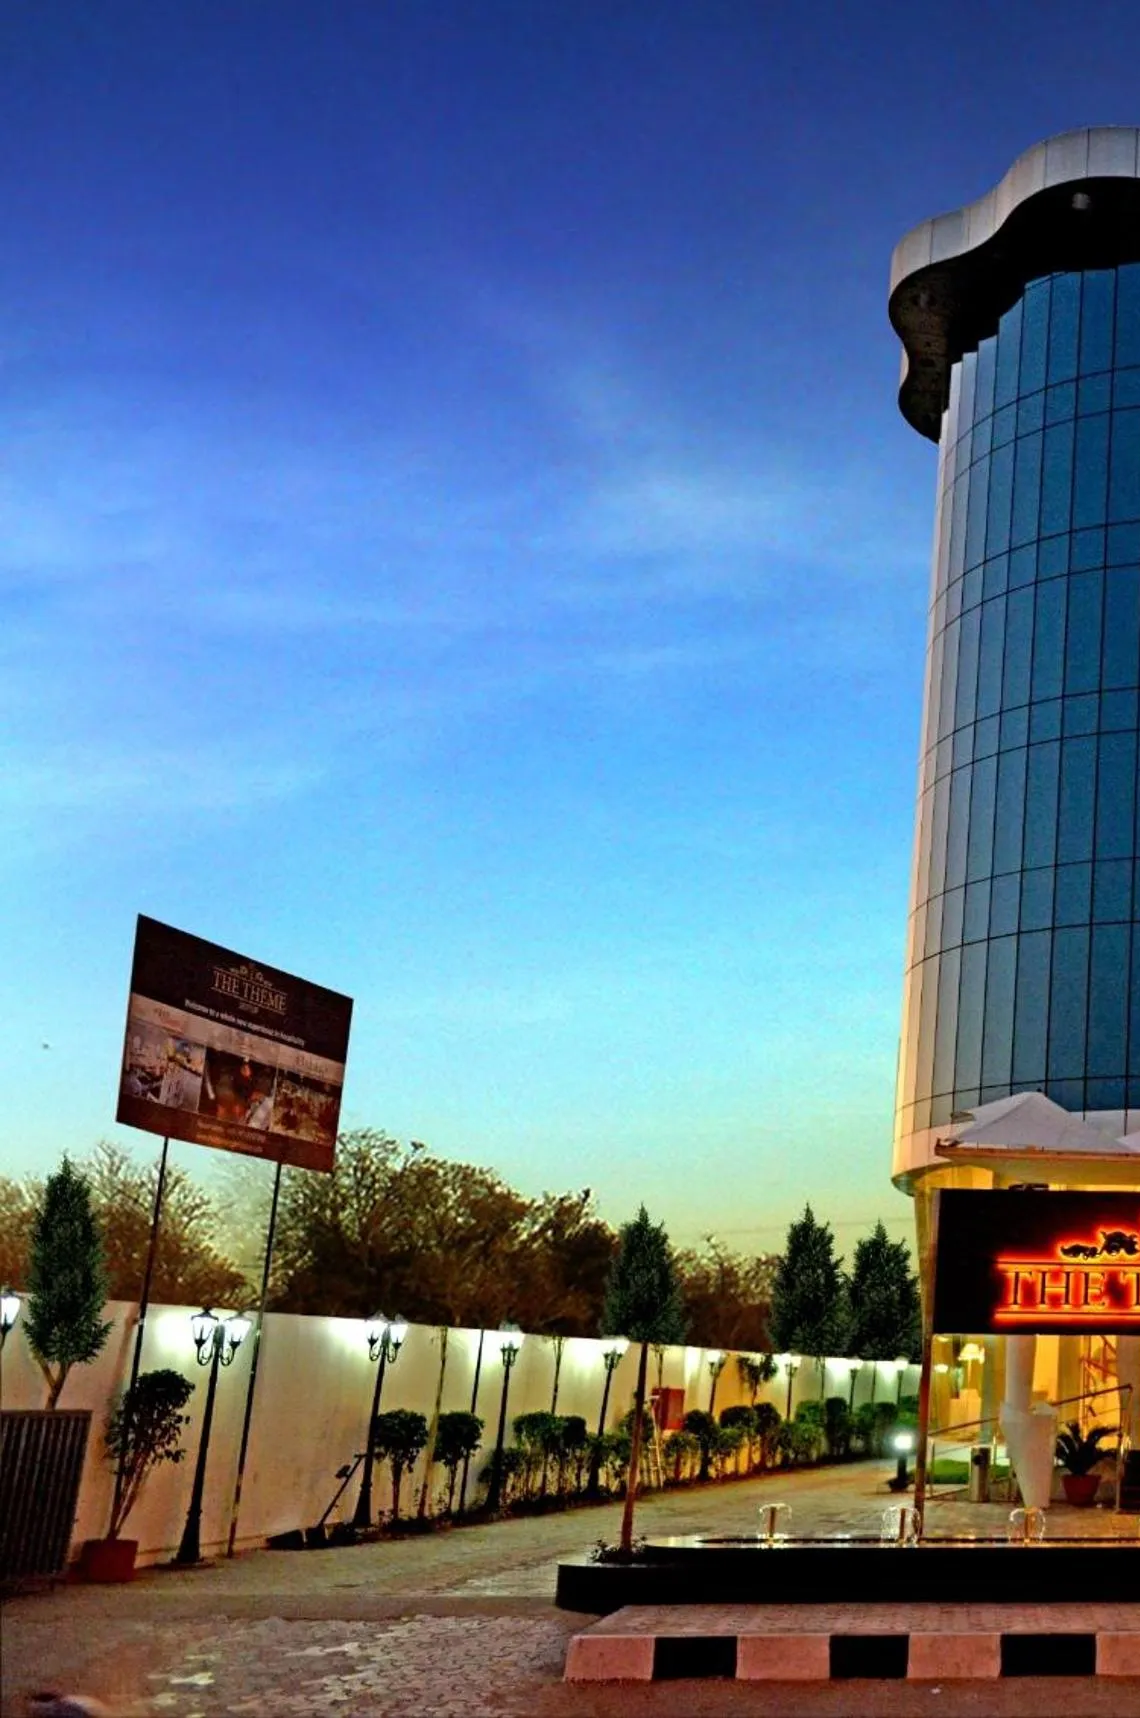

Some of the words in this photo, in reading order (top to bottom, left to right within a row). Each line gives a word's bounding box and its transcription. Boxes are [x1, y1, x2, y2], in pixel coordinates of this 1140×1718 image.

[213, 970, 240, 994] THE
[242, 982, 287, 1010] THEME
[1002, 1269, 1106, 1309] THE
